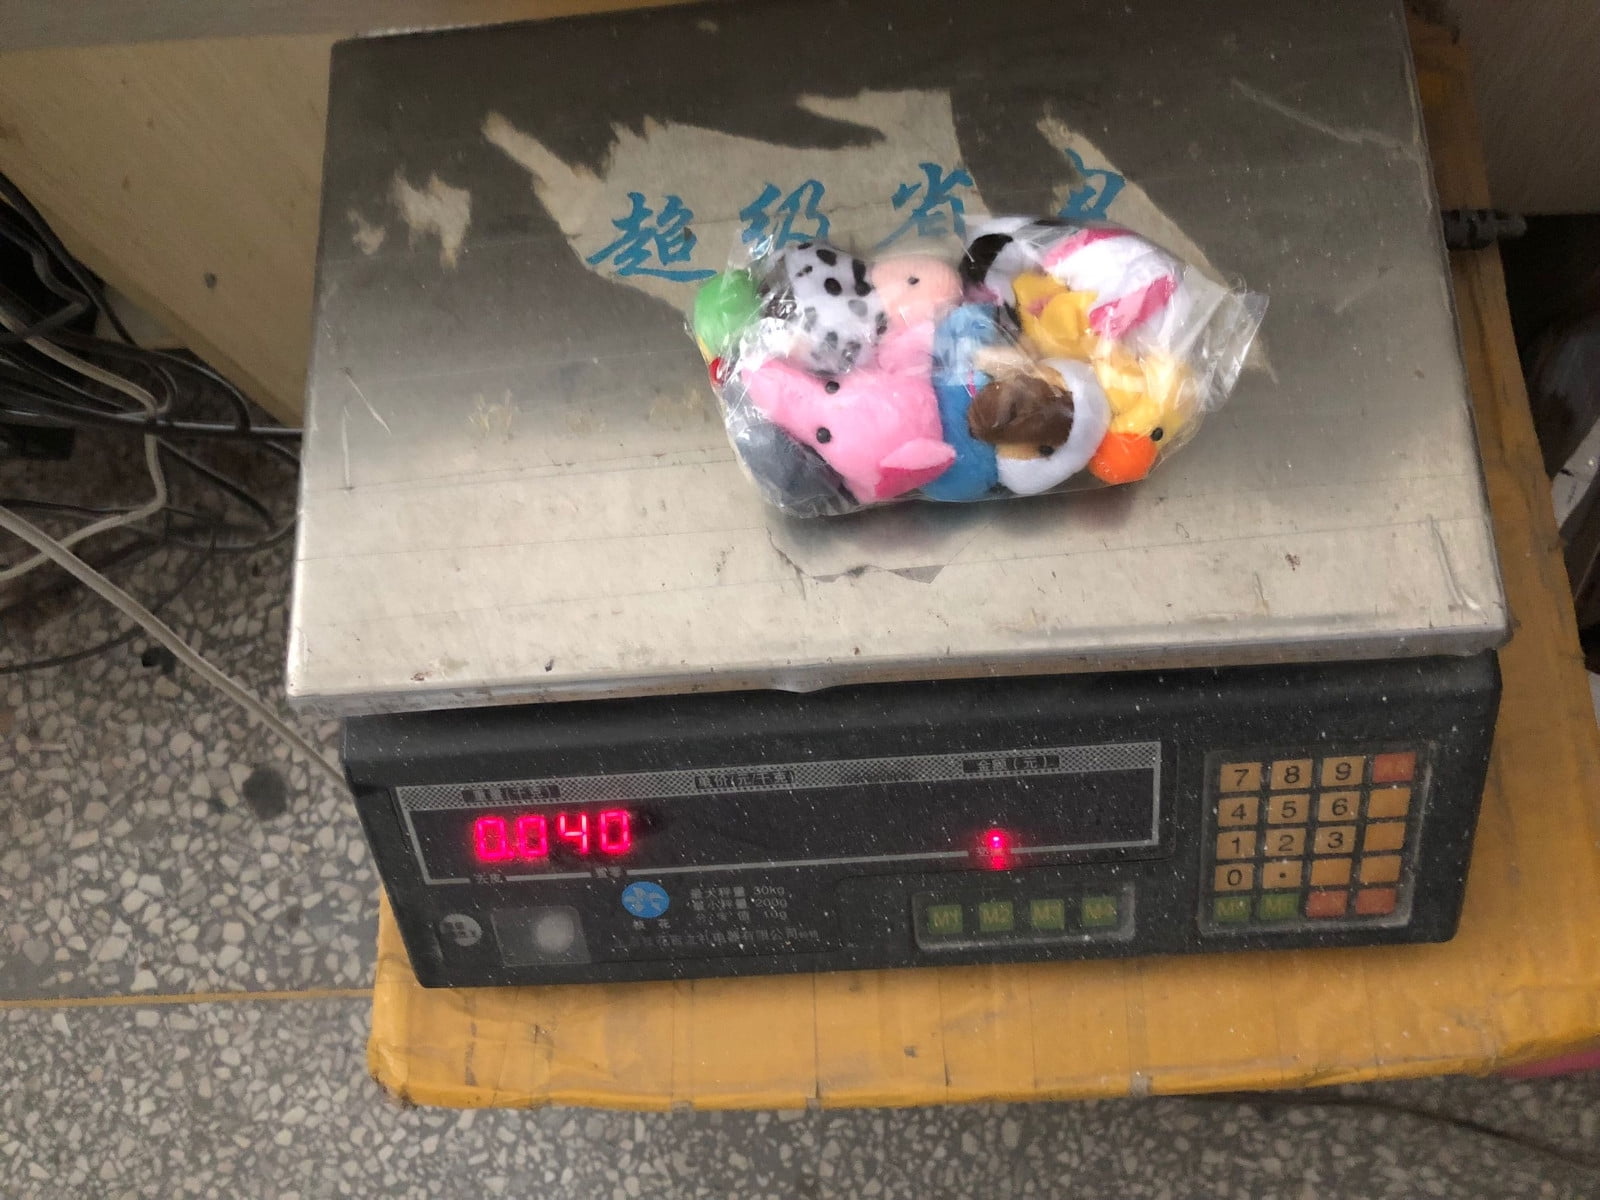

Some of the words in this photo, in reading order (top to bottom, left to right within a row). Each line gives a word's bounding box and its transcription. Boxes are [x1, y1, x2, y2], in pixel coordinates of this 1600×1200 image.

[1233, 768, 1249, 787] 7
[1284, 765, 1300, 784] 8
[1335, 762, 1352, 781] 9
[1231, 803, 1247, 820] 4
[1281, 800, 1297, 819] 5
[1331, 798, 1348, 816] 6
[472, 808, 634, 862] 0.040
[1231, 837, 1241, 854] 1
[1278, 834, 1295, 852] 2
[1327, 832, 1344, 849] 3
[1226, 869, 1243, 886] 0
[933, 910, 961, 928] M1
